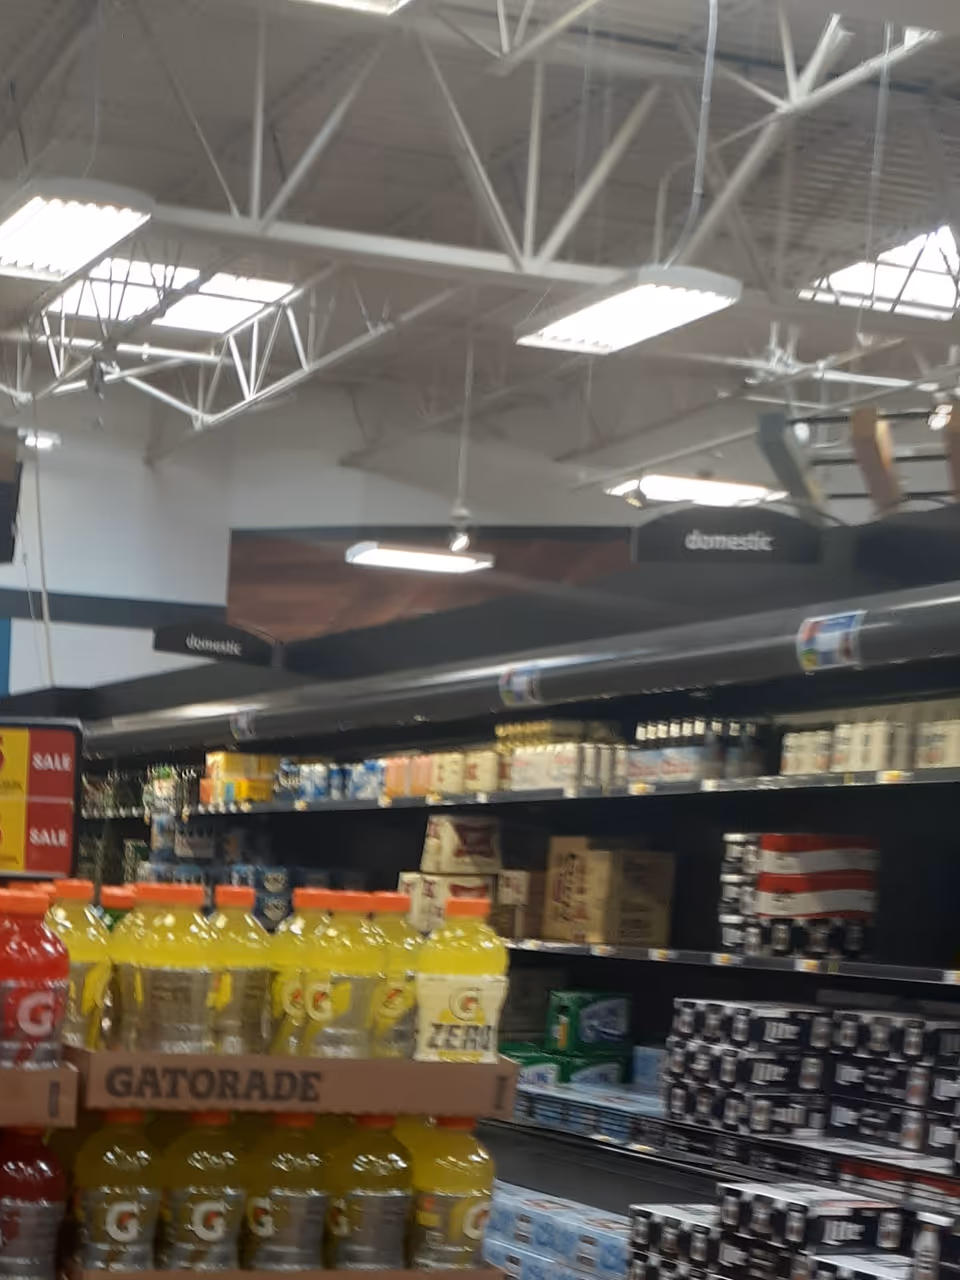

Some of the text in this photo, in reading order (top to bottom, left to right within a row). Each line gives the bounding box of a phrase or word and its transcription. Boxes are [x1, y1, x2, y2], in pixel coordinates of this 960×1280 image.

[685, 529, 774, 551] domestic
[185, 631, 241, 656] domestic
[32, 752, 72, 771] SALE
[29, 828, 69, 848] SALE
[13, 991, 55, 1036] G
[104, 1066, 321, 1102] GATORADE
[105, 1201, 139, 1242] G
[190, 1201, 224, 1242] G
